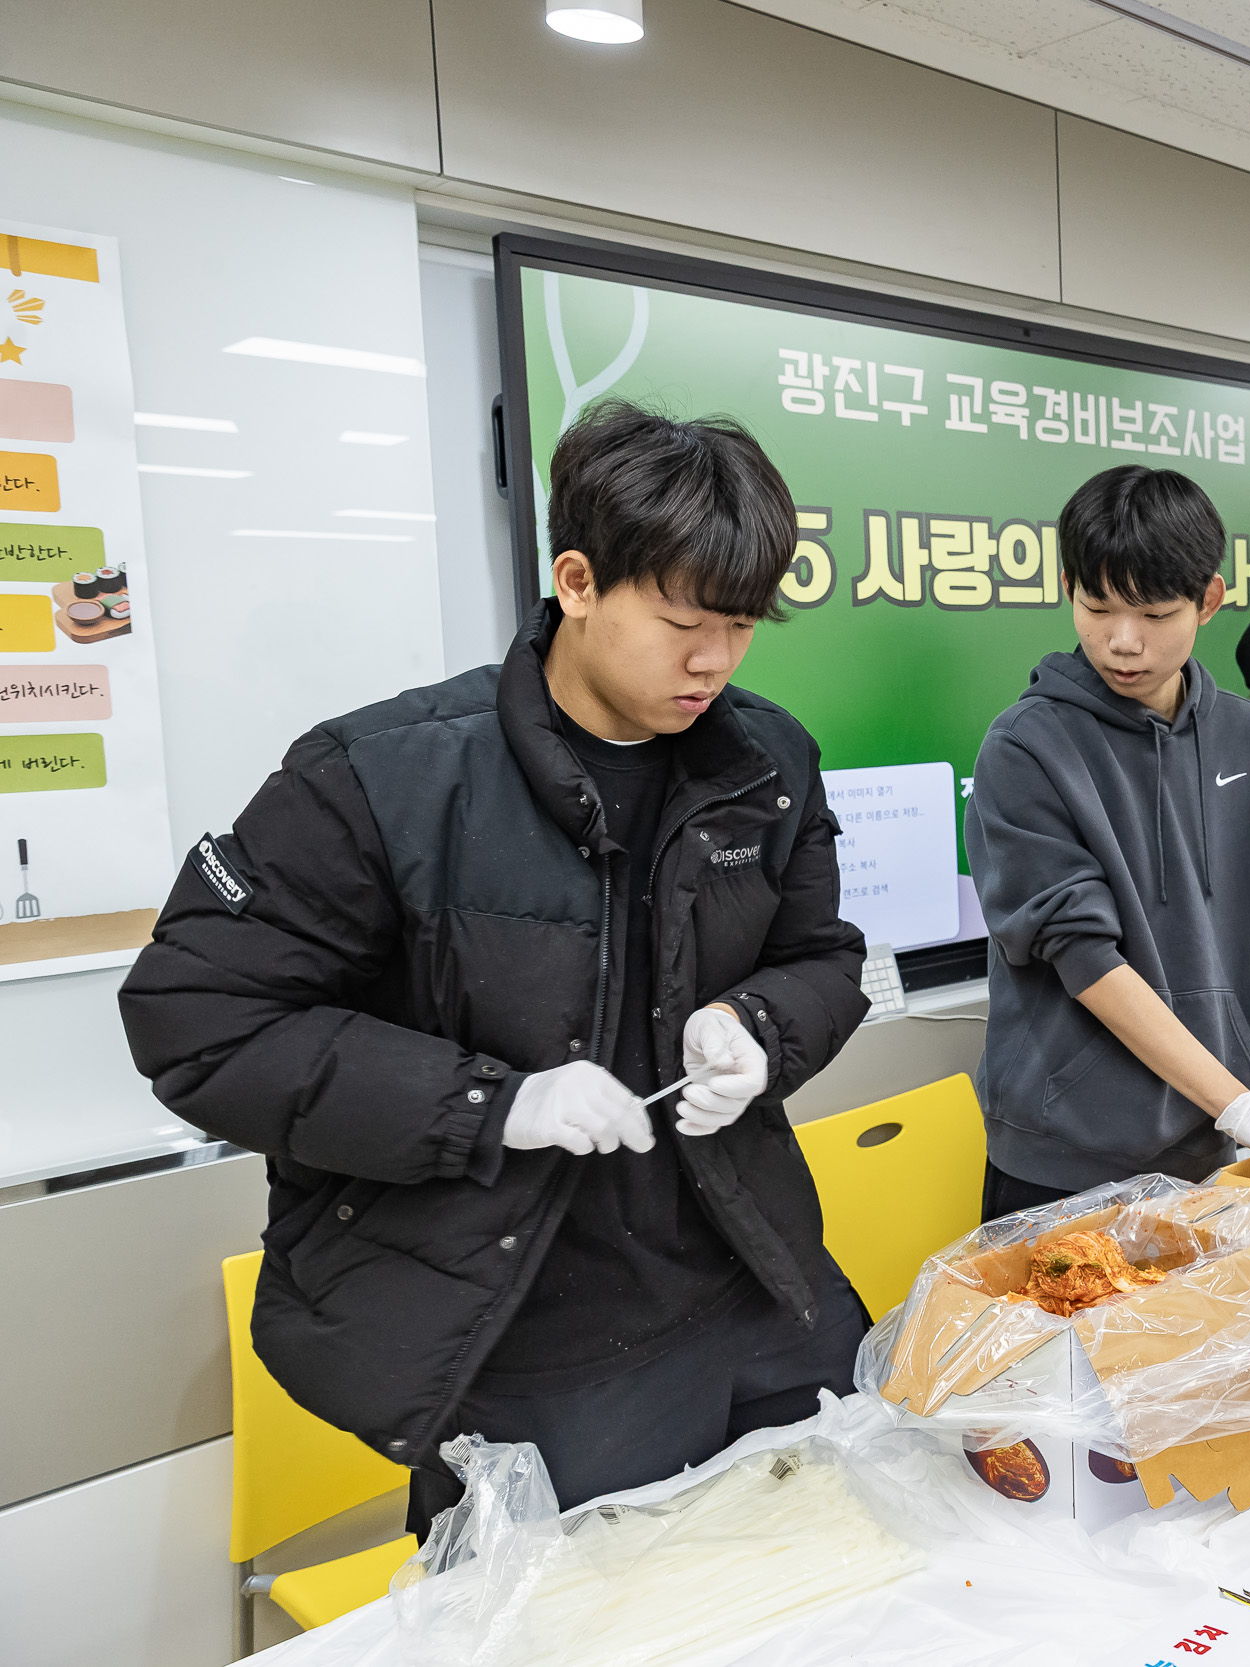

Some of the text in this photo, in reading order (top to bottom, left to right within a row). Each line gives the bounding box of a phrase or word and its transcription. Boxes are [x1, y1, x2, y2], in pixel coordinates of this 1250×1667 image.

[777, 348, 929, 427] 광진구
[945, 372, 1246, 465] 교육경비보조사업
[855, 514, 1060, 607] 사랑의
[22, 755, 85, 773] 버린다.
[847, 788, 874, 799] 이미지
[877, 785, 894, 797] 열기
[845, 812, 864, 824] 다른
[866, 809, 899, 822] 이름으로
[860, 860, 877, 871] 복사
[843, 884, 889, 899] 렌즈로 검색
[1172, 1624, 1229, 1656] 김치
